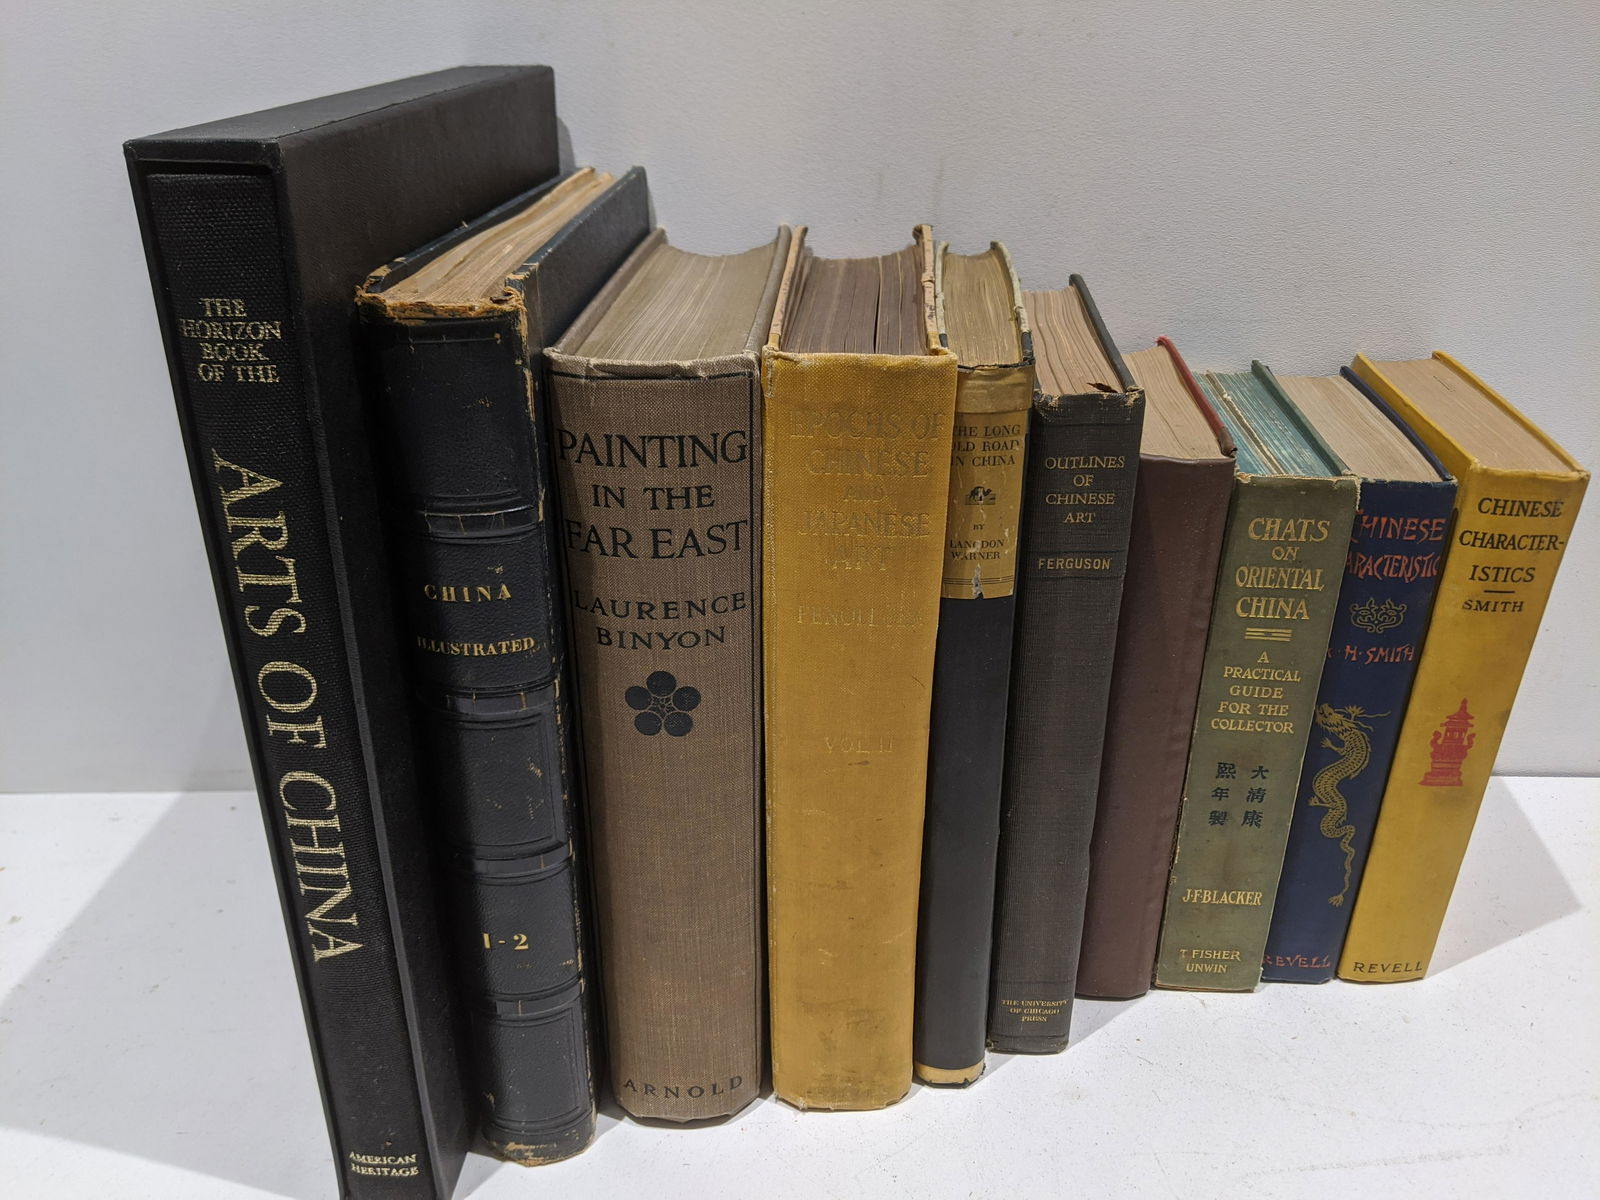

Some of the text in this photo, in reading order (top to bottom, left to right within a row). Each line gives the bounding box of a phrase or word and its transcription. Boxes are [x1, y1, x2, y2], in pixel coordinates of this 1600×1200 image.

[199, 298, 247, 317] THE
[180, 318, 282, 340] HORIZON
[200, 343, 269, 361] BOOK
[197, 363, 280, 383] OF THE
[984, 424, 1021, 437] LONG
[557, 428, 748, 469] PAINTING
[983, 439, 1020, 452] ROAD
[972, 455, 1016, 467] CHINA
[1045, 456, 1126, 470] OUTLINES
[1073, 475, 1095, 487] OF
[591, 484, 716, 511] IN THE
[1045, 493, 1117, 505] CHINESE
[1478, 497, 1564, 518] CHINESE
[1064, 512, 1095, 523] ART
[1247, 517, 1331, 542] CHATS
[565, 519, 749, 560] FAR EAST
[1459, 529, 1565, 552] CHARACTER-
[951, 551, 1001, 561] WARNER
[1271, 546, 1300, 561] ON
[1038, 558, 1112, 570] FERGUSON
[1235, 565, 1325, 591] ORIENTAL
[1469, 564, 1536, 583] ISTICS
[424, 583, 512, 603] CHINA
[573, 591, 747, 621] LAURENCE
[1235, 596, 1310, 620] CHINA
[1462, 599, 1525, 613] SMITH
[595, 625, 726, 651] BINYON
[416, 636, 536, 657] ILLUSTRATED
[1257, 651, 1270, 664] A
[1223, 666, 1301, 682] PRACTICAL
[1229, 685, 1284, 699] GUIDE
[211, 447, 364, 963] ARTS OF CHINA
[1217, 701, 1289, 717] FOR THE
[1211, 718, 1294, 734] COLLECTOR
[1192, 949, 1241, 961] FISHER
[1262, 954, 1332, 969] REVELL
[1186, 962, 1228, 974] UNWIN
[1353, 961, 1423, 974] REVELL
[1021, 999, 1067, 1007] UNIVERSITY
[623, 1075, 743, 1099] ARNOLD
[349, 1151, 417, 1165] AMERICAN
[351, 1163, 420, 1177] HERITAGE
